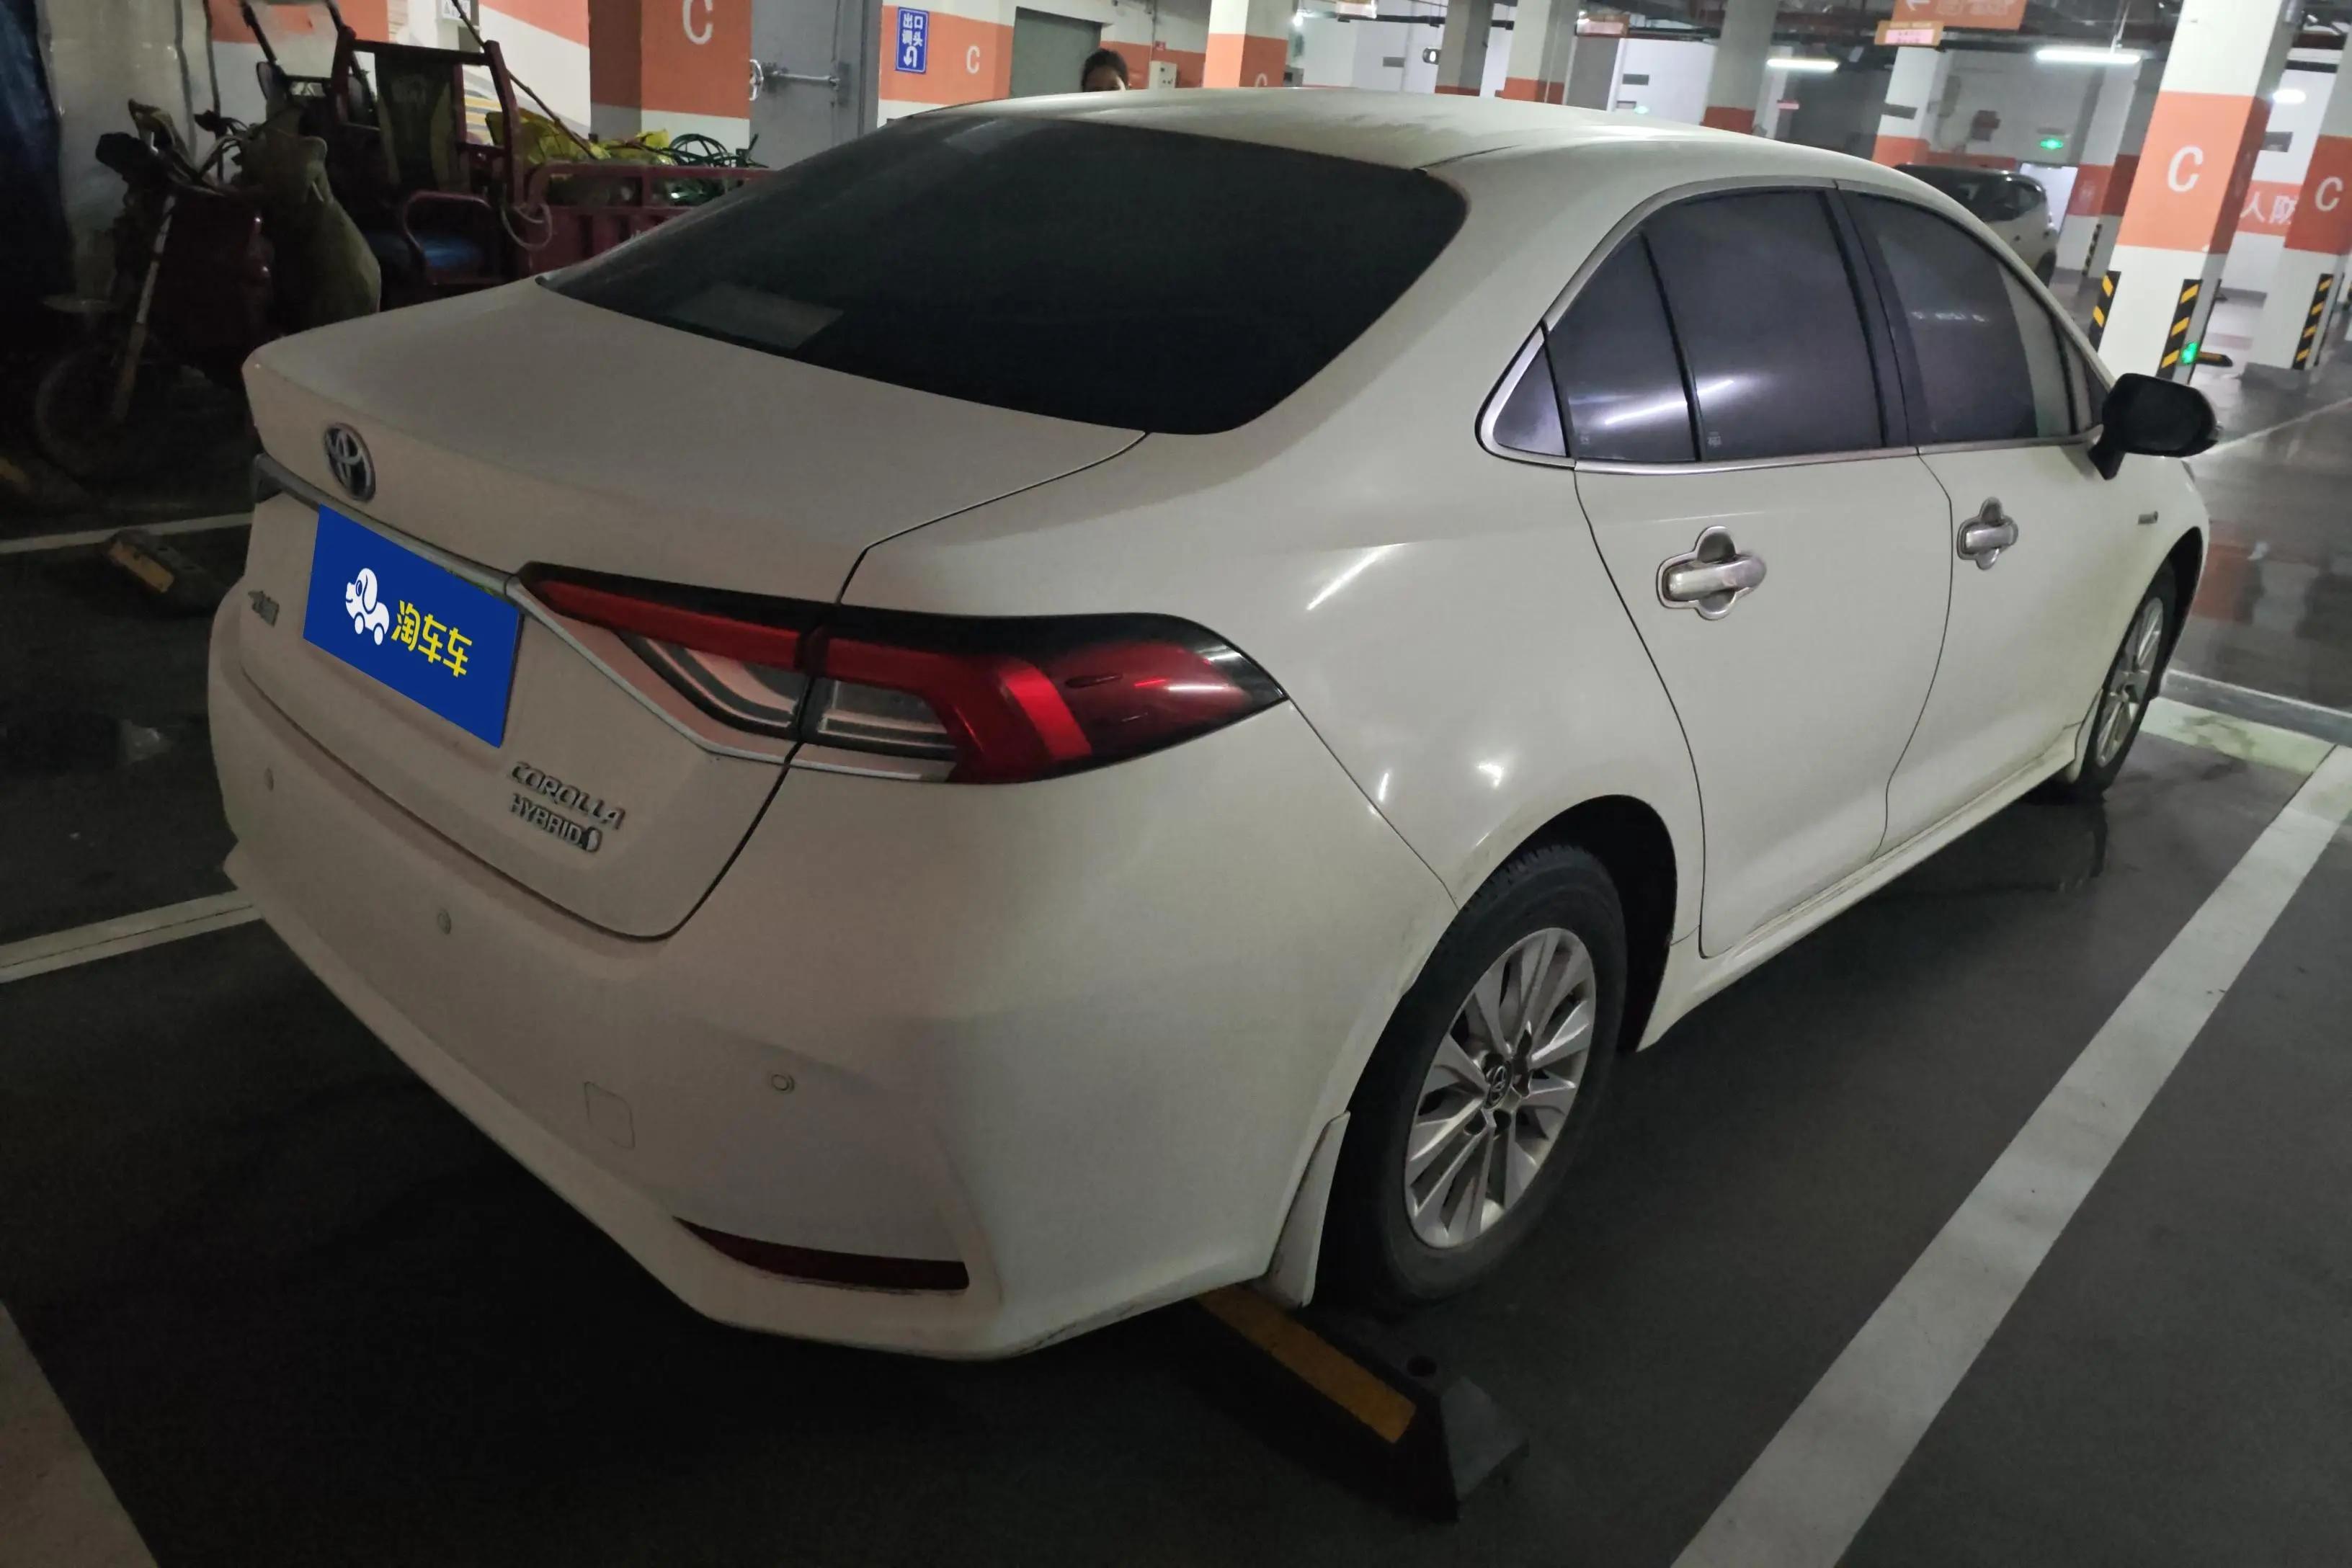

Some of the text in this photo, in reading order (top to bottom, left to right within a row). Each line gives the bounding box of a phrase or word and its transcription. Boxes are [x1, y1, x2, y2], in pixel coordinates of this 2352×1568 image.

[682, 0, 713, 45] C
[903, 12, 923, 29] 出口
[967, 45, 980, 74] C
[2168, 146, 2203, 192] C
[2315, 177, 2343, 212] C
[512, 761, 625, 829] COROLLA
[509, 793, 584, 847] HYBRID
